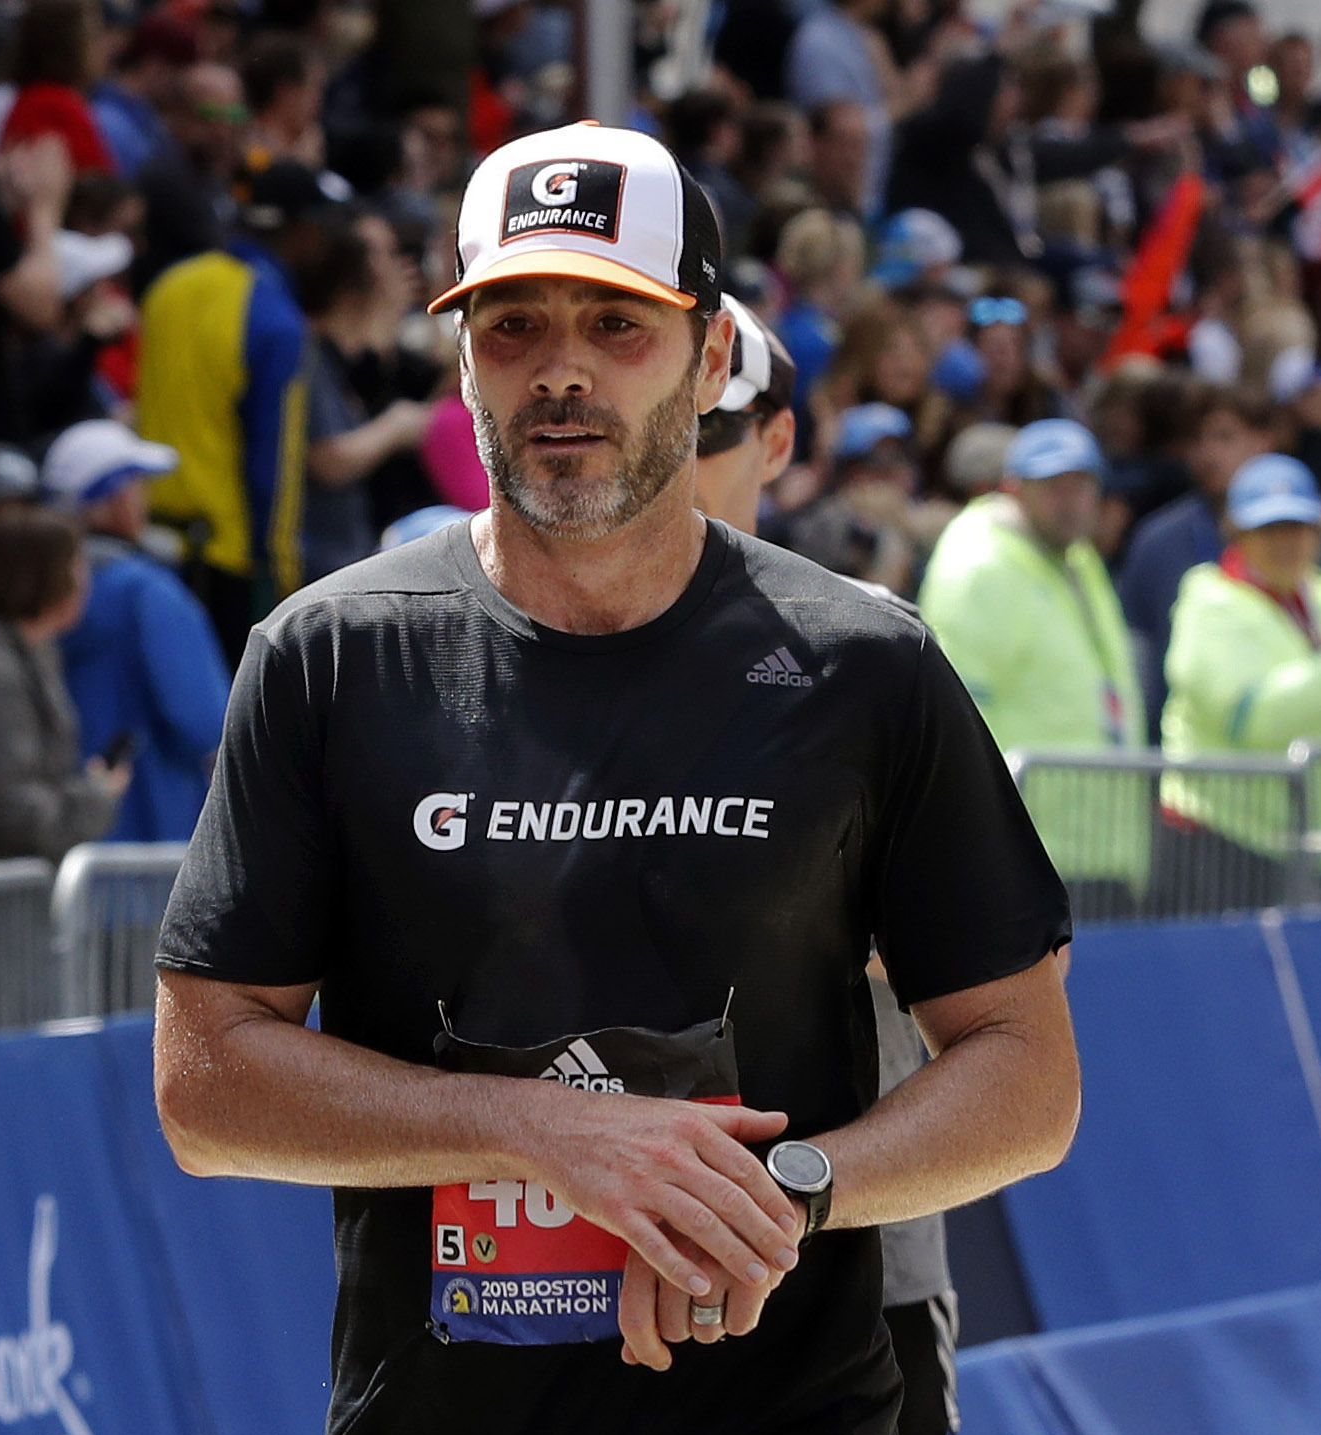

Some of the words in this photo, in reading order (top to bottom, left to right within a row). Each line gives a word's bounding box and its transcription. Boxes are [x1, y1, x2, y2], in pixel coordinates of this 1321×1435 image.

[507, 208, 608, 232] ENDURANCE
[746, 669, 813, 687] adidas
[414, 793, 468, 851] G
[487, 797, 774, 841] ENDURANCE
[442, 1230, 460, 1260] 5
[481, 1281, 518, 1297] 2019
[522, 1279, 607, 1296] BOSTON
[482, 1299, 607, 1315] MARATHON
